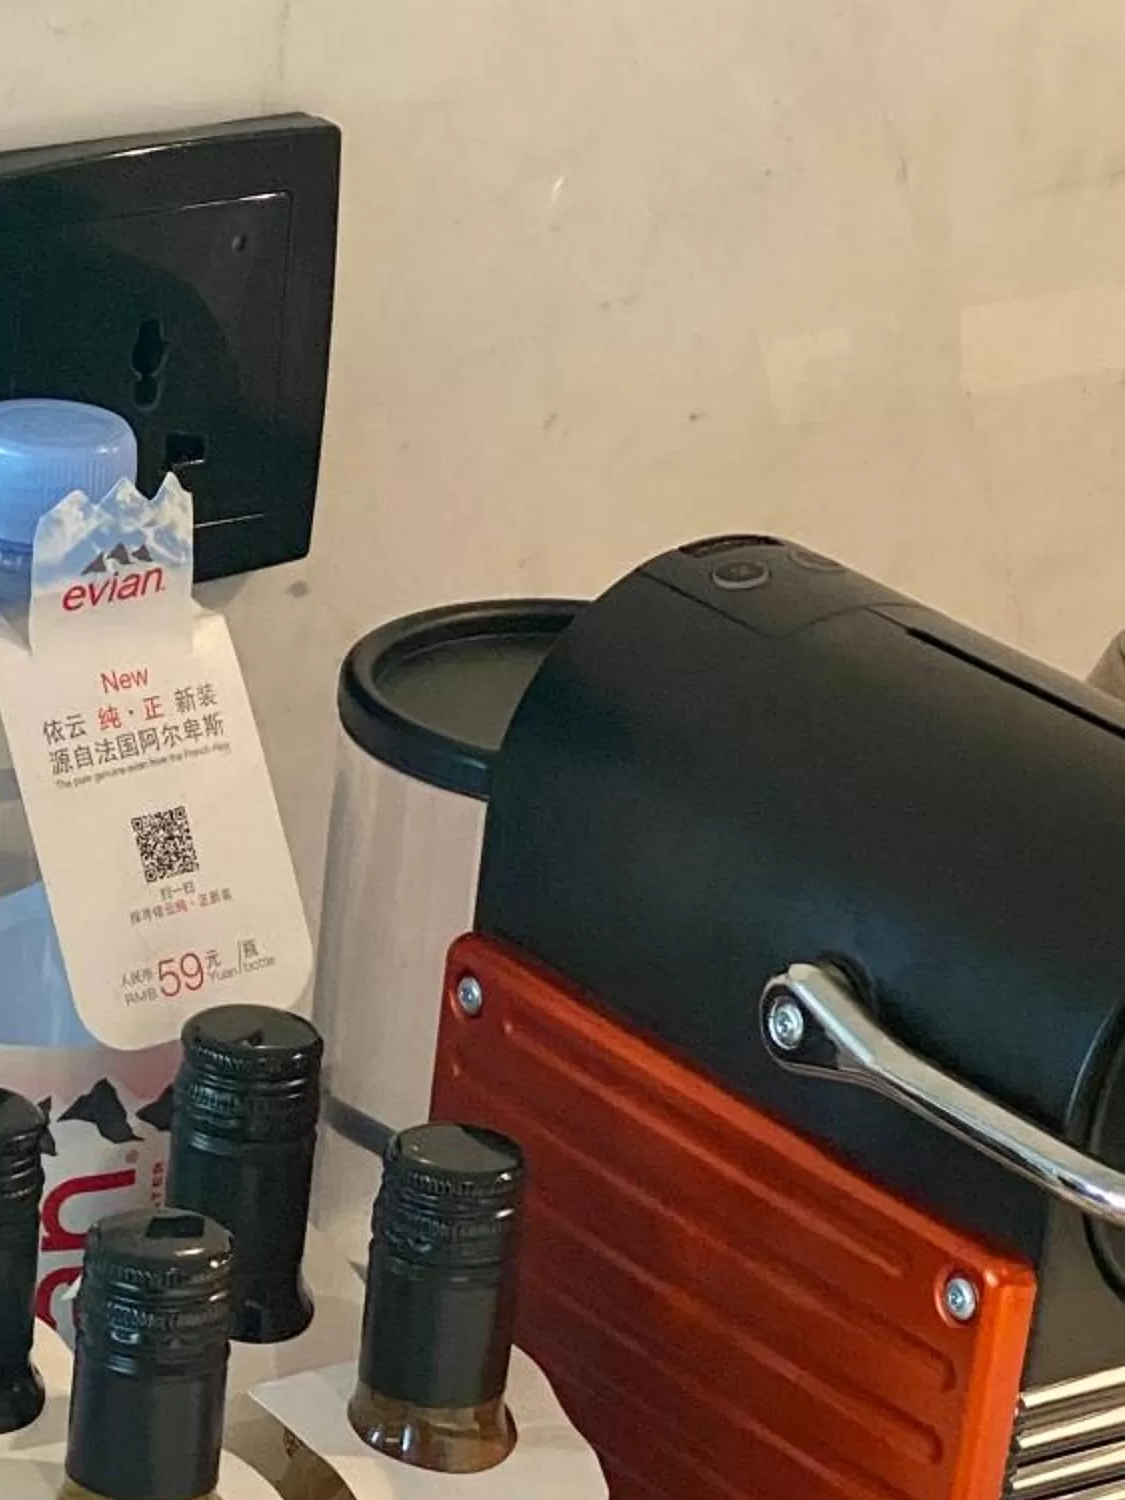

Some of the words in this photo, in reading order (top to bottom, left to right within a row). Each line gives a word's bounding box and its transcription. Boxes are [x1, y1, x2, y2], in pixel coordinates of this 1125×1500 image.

[61, 565, 164, 612] evian
[101, 668, 148, 693] New
[43, 714, 88, 745] 依云
[174, 683, 217, 713] 新装
[49, 711, 224, 775] 源自法国阿尔卑斯
[158, 953, 204, 997] 59
[205, 950, 221, 968] 元
